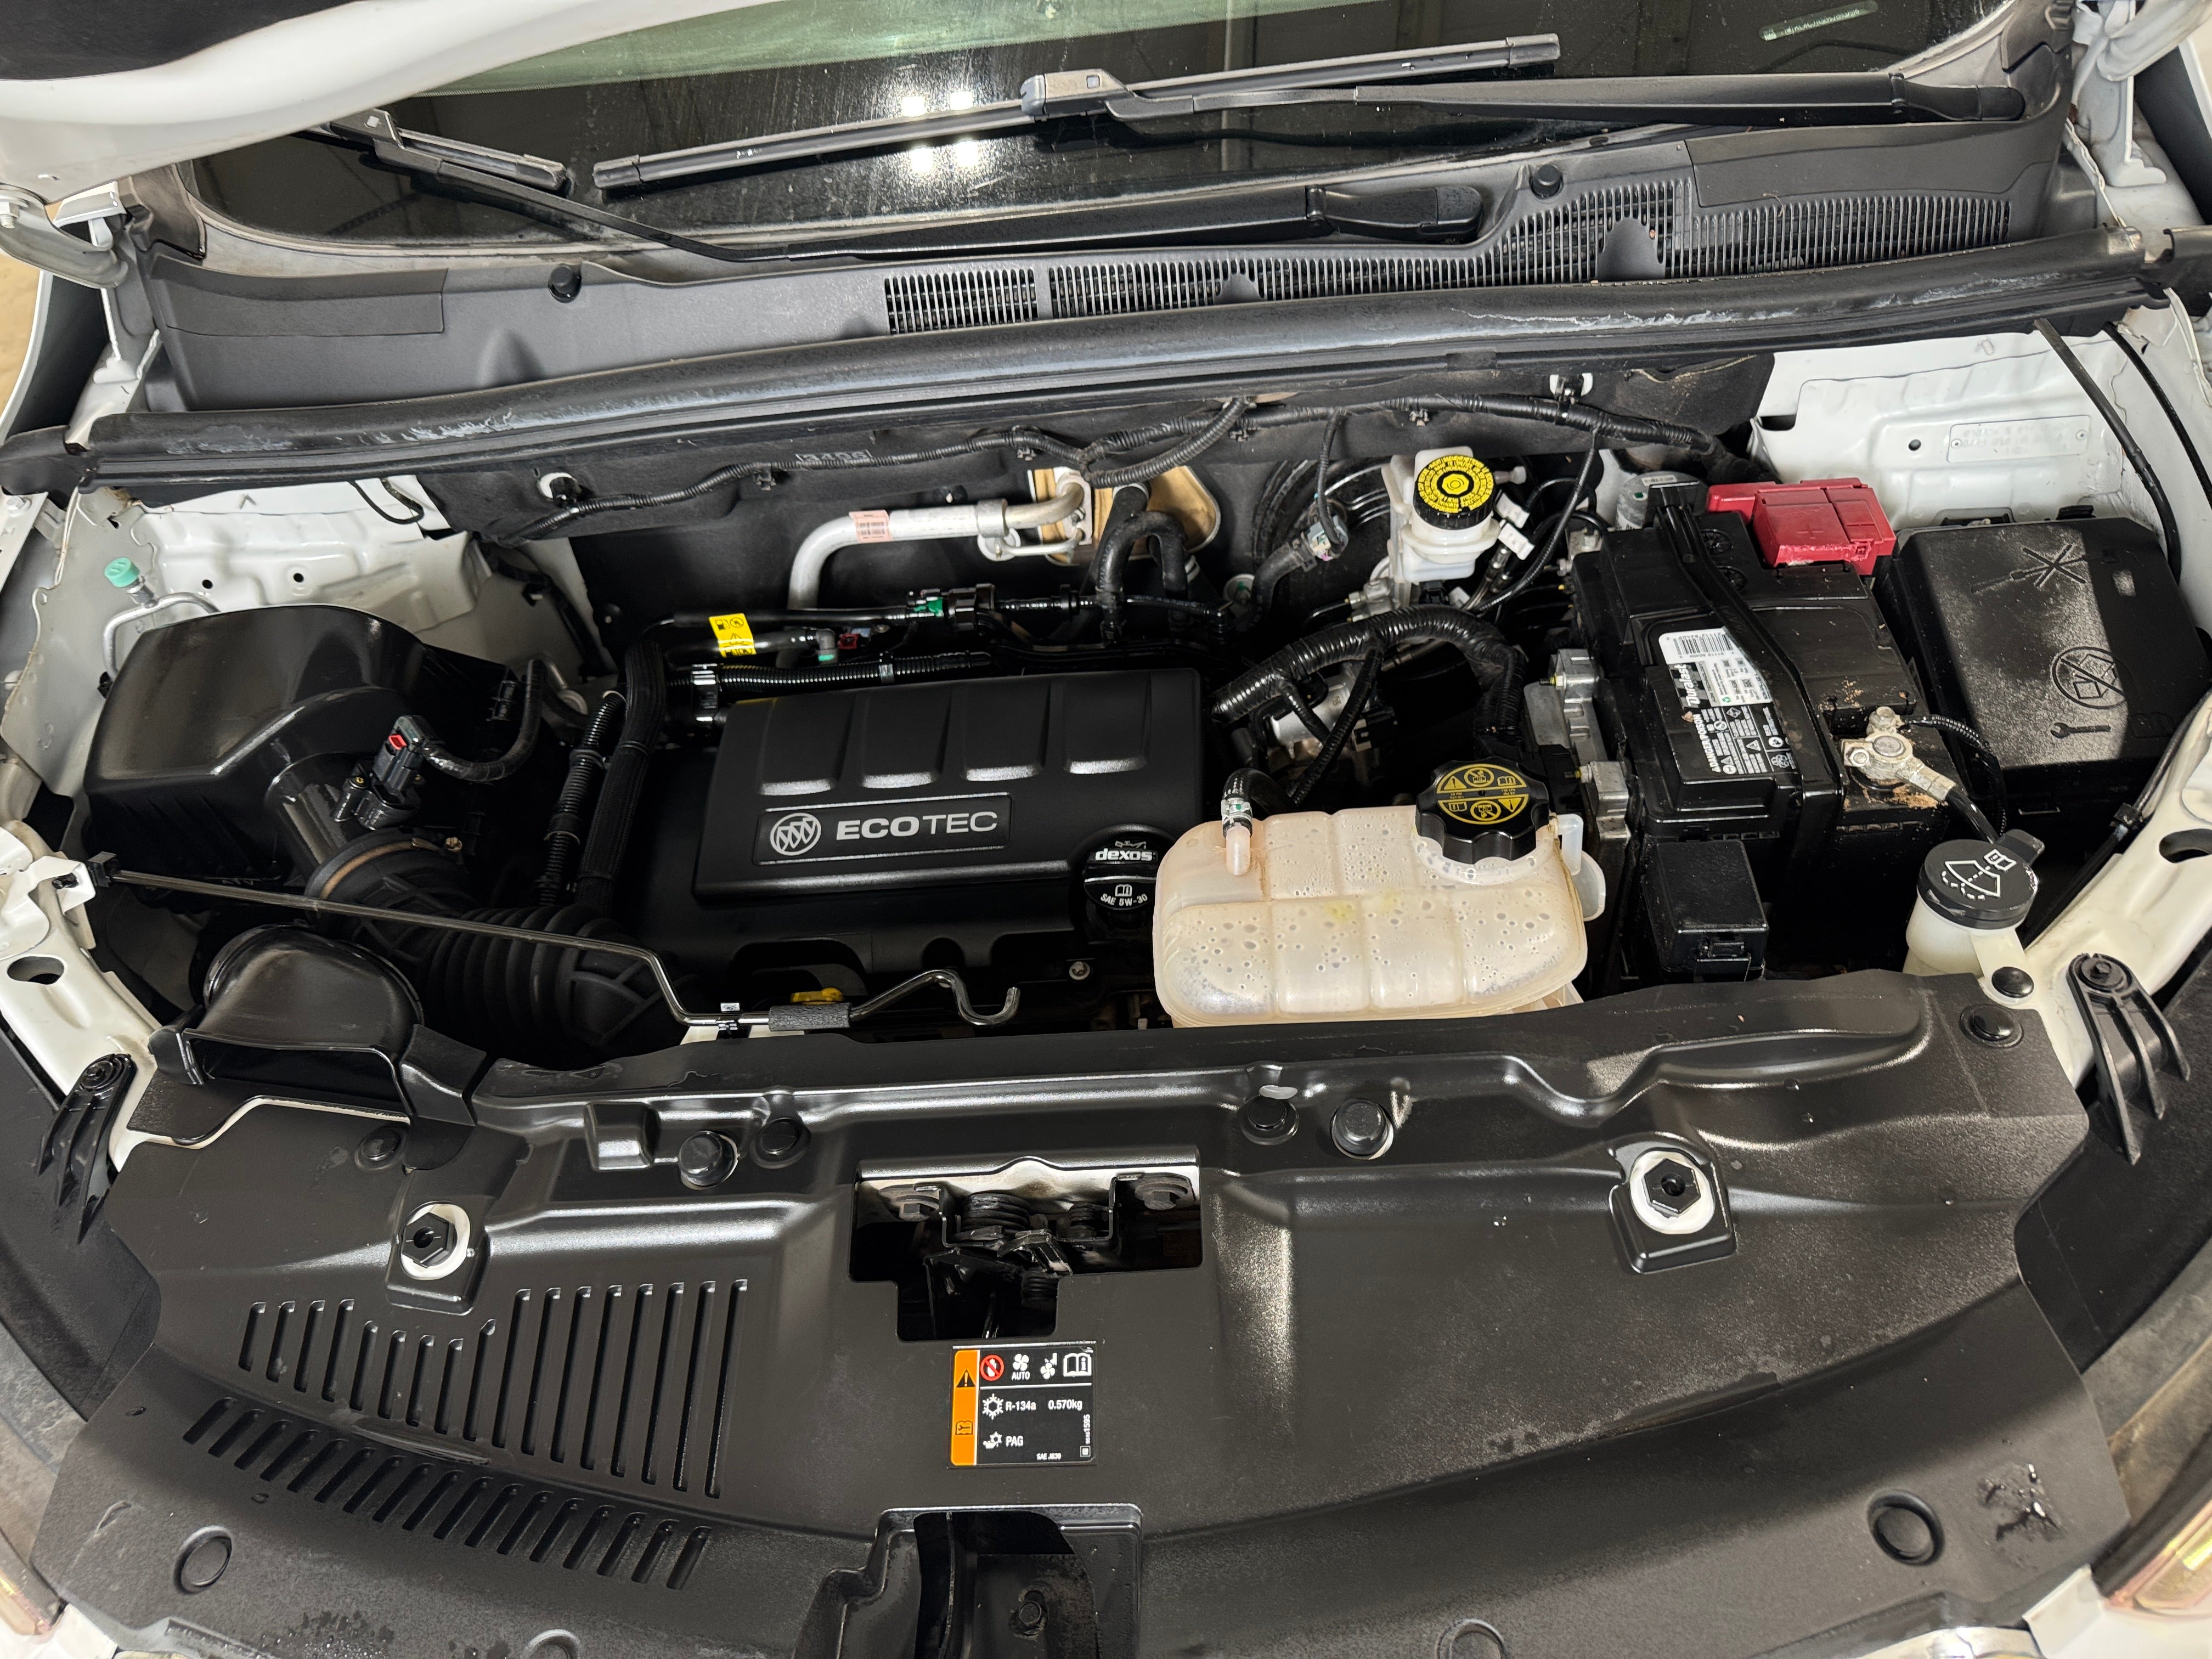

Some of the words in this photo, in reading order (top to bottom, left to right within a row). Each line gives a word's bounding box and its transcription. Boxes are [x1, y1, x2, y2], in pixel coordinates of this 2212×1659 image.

[1674, 664, 1700, 707] Duralast
[836, 811, 998, 840] ECOTEC
[1095, 848, 1153, 861] dexos
[1100, 893, 1116, 906] SAE
[1119, 893, 1148, 906] 5W-30
[1011, 1371, 1030, 1381] AUTO
[1005, 1400, 1036, 1412] R-134a
[1047, 1399, 1083, 1412] 0.570kg
[1006, 1435, 1024, 1447] PAG
